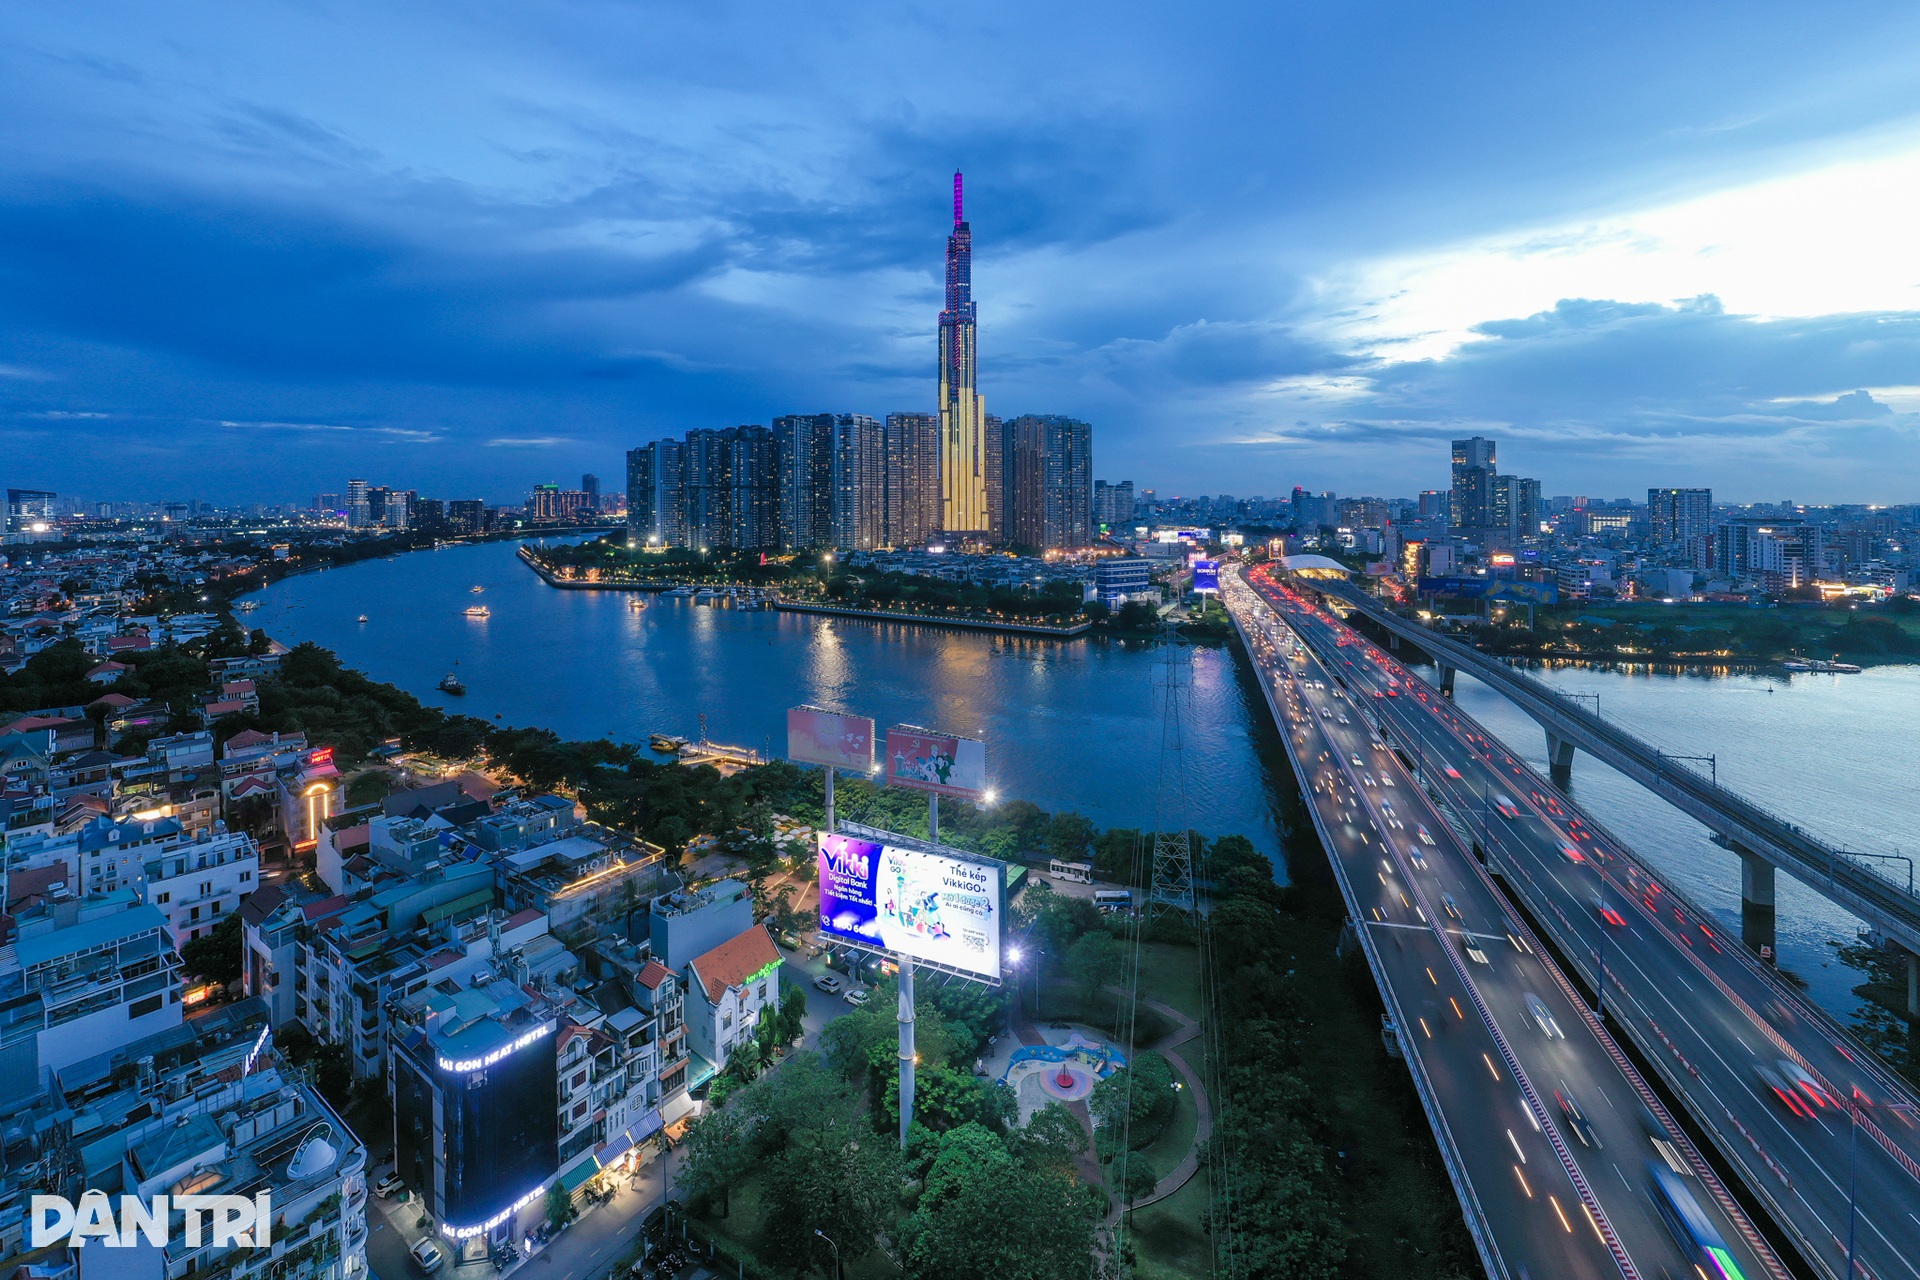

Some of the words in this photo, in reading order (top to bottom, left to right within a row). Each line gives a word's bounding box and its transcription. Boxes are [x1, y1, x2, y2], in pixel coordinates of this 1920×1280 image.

[577, 849, 627, 876] HOTEL
[821, 842, 869, 880] Vikki
[970, 870, 987, 883] kép
[828, 873, 850, 885] Digital
[850, 878, 868, 889] Bank
[439, 1057, 453, 1071] SAI
[455, 1058, 482, 1072] GON
[484, 1043, 513, 1066] HEAT
[515, 1025, 549, 1050] HOTEL
[442, 1223, 455, 1238] SAI
[457, 1224, 482, 1239] GON
[484, 1207, 512, 1232] HEAT
[513, 1185, 545, 1213] HOTEL
